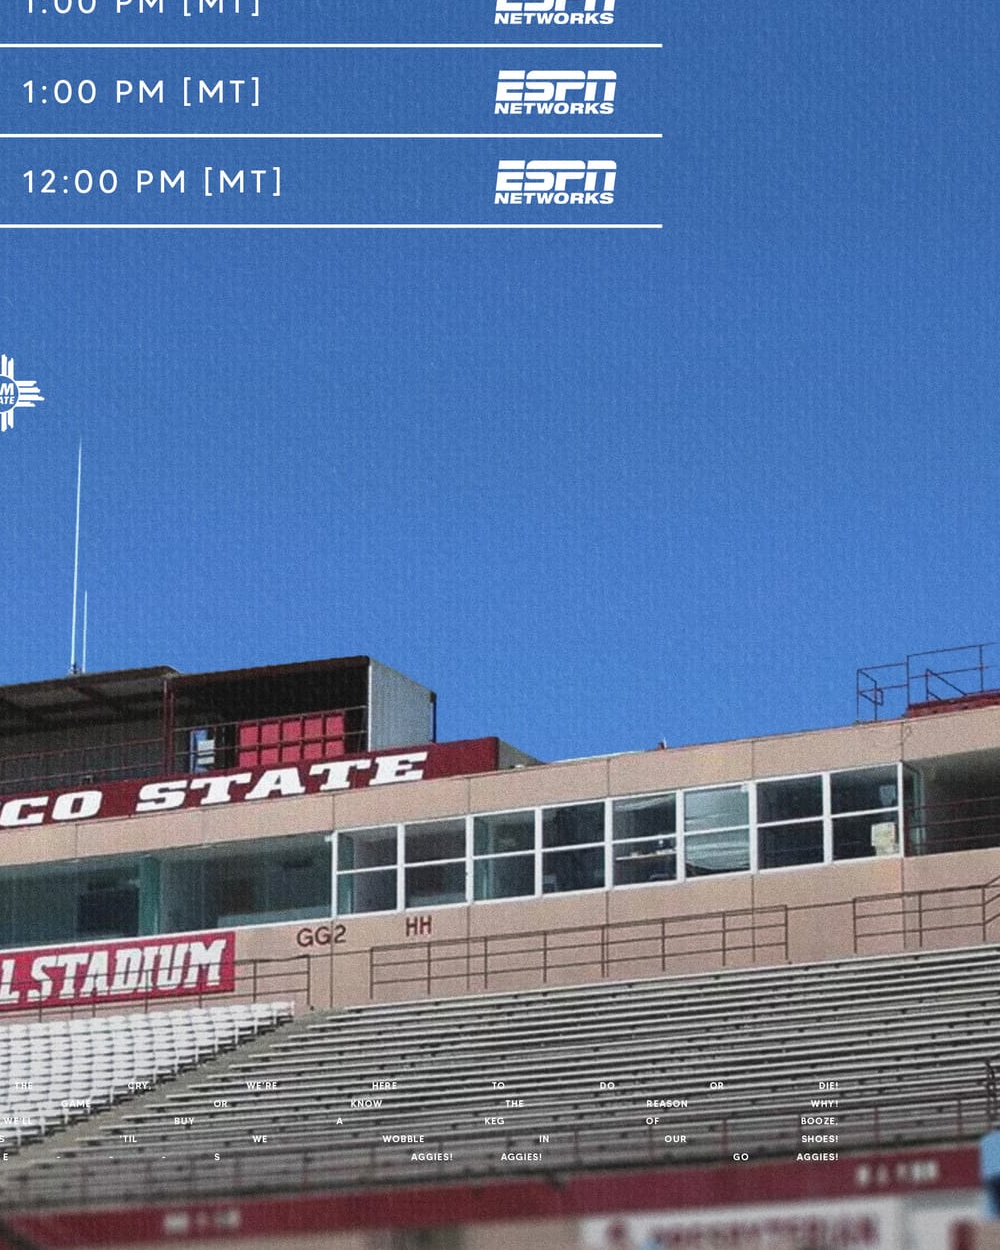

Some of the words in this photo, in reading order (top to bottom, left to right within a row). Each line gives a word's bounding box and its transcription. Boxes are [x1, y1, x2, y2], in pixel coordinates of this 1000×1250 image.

[134, 750, 429, 813] STATE
[296, 924, 346, 947] GG2
[405, 915, 432, 937] HH
[26, 939, 230, 1002] STADIUM
